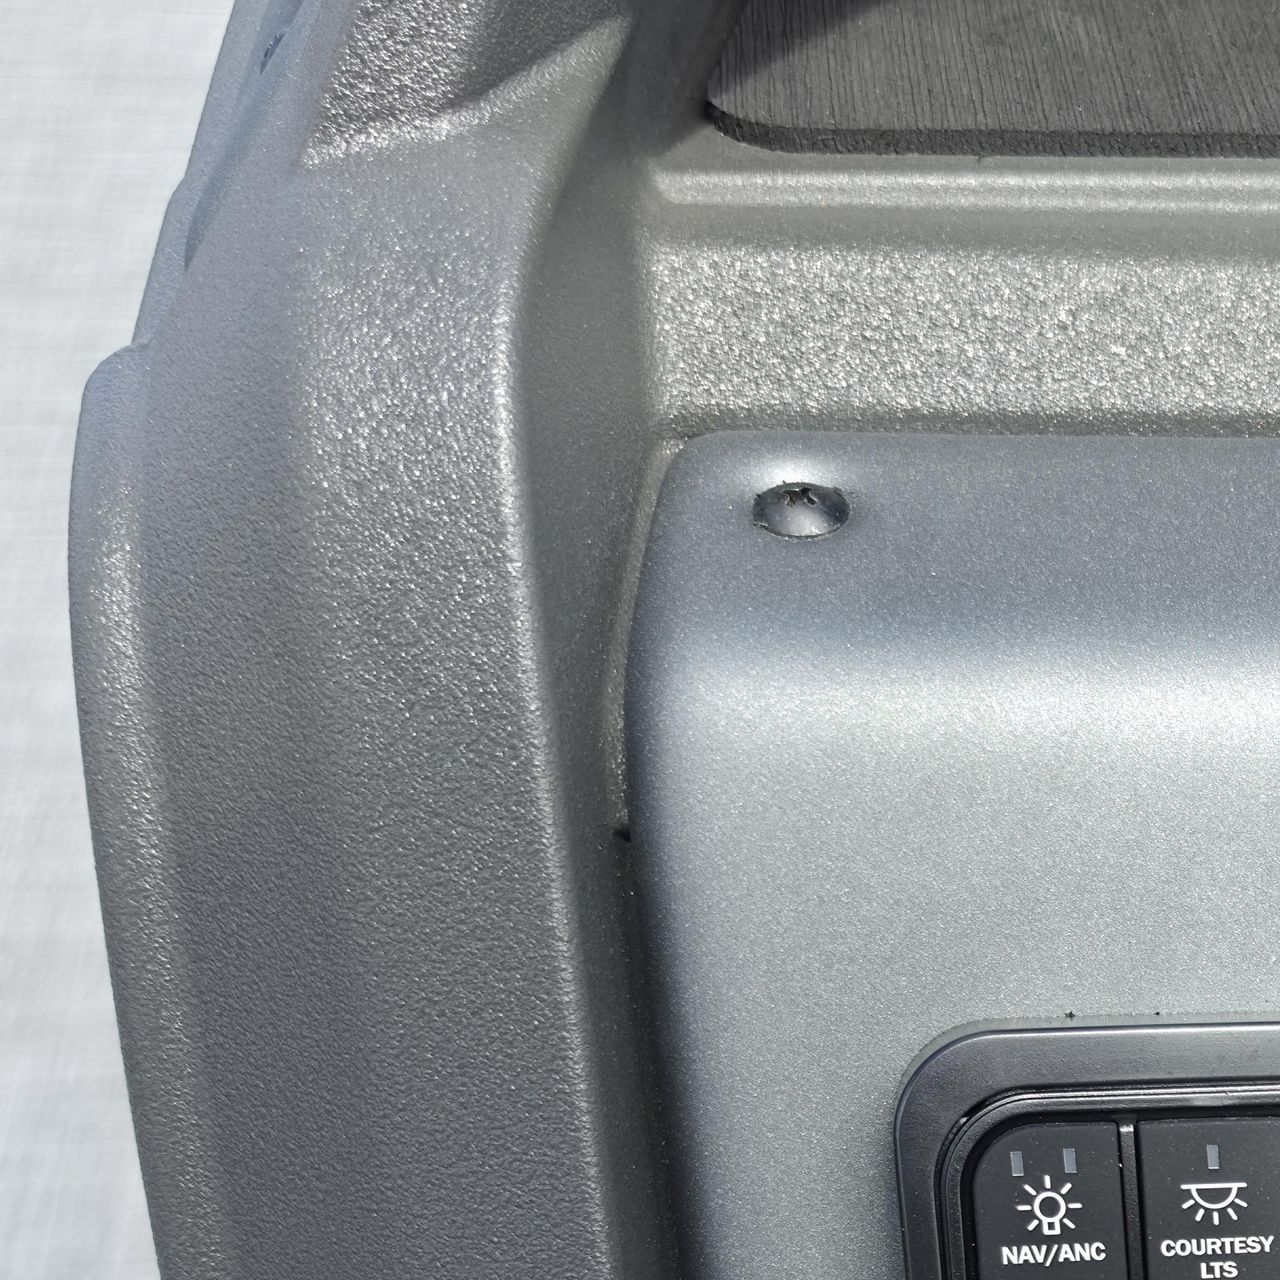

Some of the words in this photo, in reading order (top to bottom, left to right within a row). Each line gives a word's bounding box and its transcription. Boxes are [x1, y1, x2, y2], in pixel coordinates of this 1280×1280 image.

[1000, 1241, 1107, 1267] NAV/ANC
[1159, 1234, 1275, 1257] COURTESY
[1199, 1260, 1239, 1280] LTS
